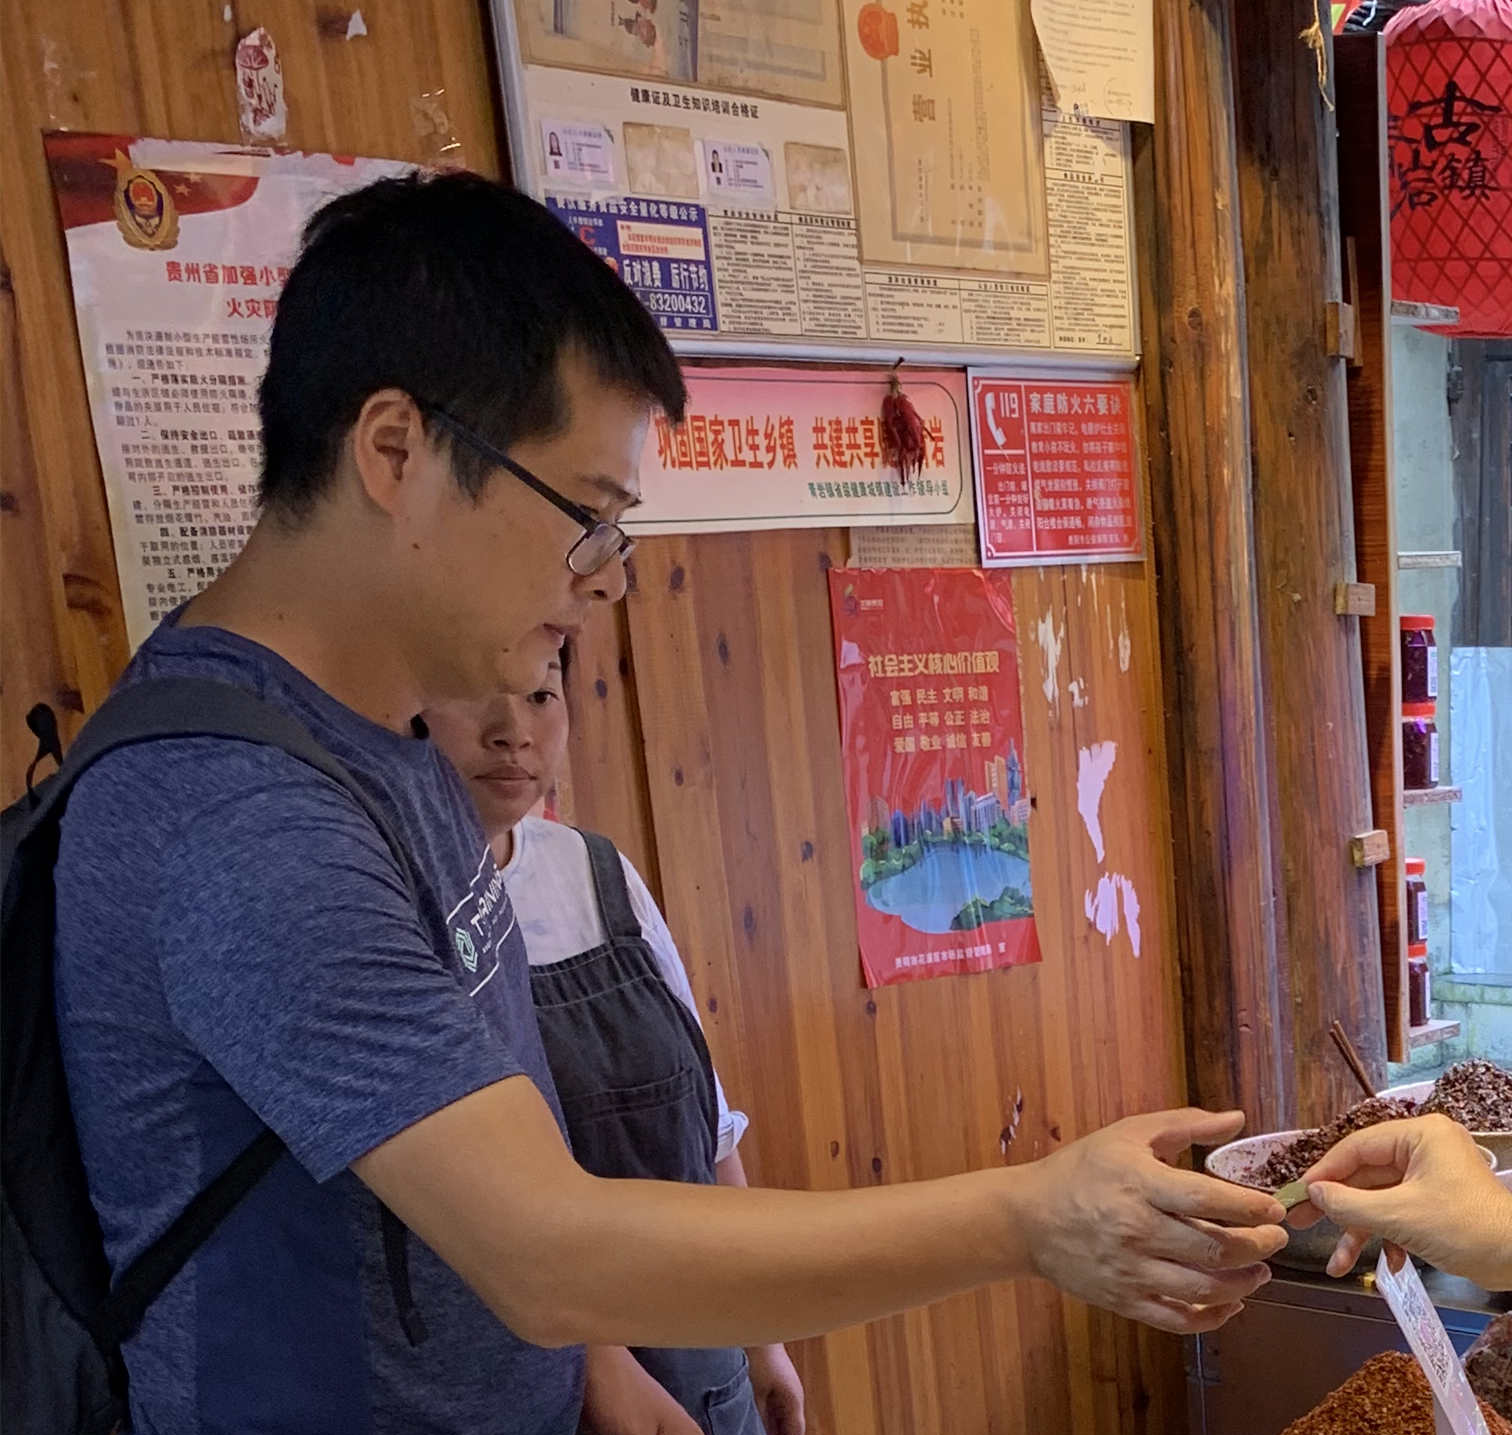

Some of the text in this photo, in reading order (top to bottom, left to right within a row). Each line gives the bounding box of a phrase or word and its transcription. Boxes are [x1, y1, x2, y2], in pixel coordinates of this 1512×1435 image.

[1000, 392, 1020, 418] 119
[868, 651, 1000, 678] 社会主义核心价值观
[890, 685, 989, 706] 富强 民主 文明 和谐
[892, 709, 990, 730] 自由 平等 公正 法治
